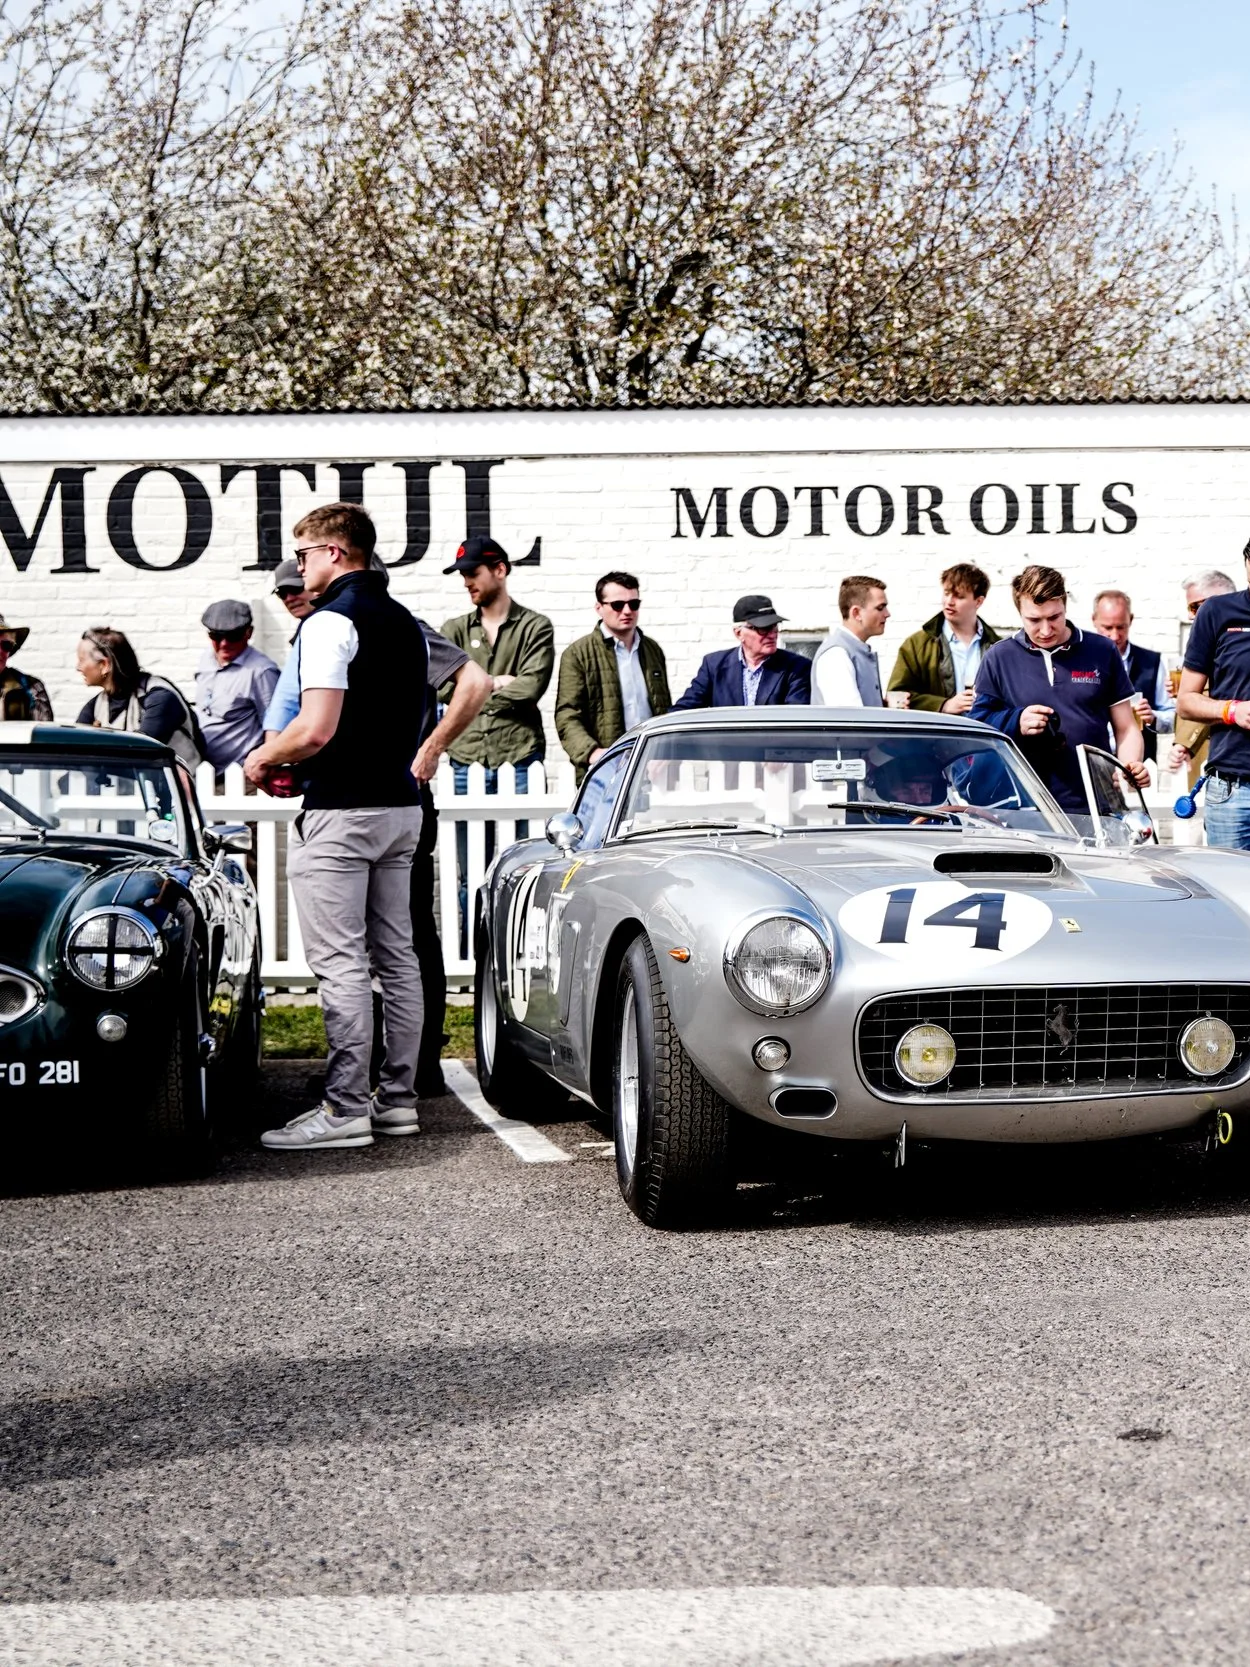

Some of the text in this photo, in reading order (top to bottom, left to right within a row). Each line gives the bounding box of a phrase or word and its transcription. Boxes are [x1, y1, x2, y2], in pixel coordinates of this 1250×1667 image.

[0, 459, 542, 573] MOTUL
[670, 481, 1138, 538] MOTOR OILS
[876, 888, 1008, 952] 14
[39, 1060, 80, 1085] 281
